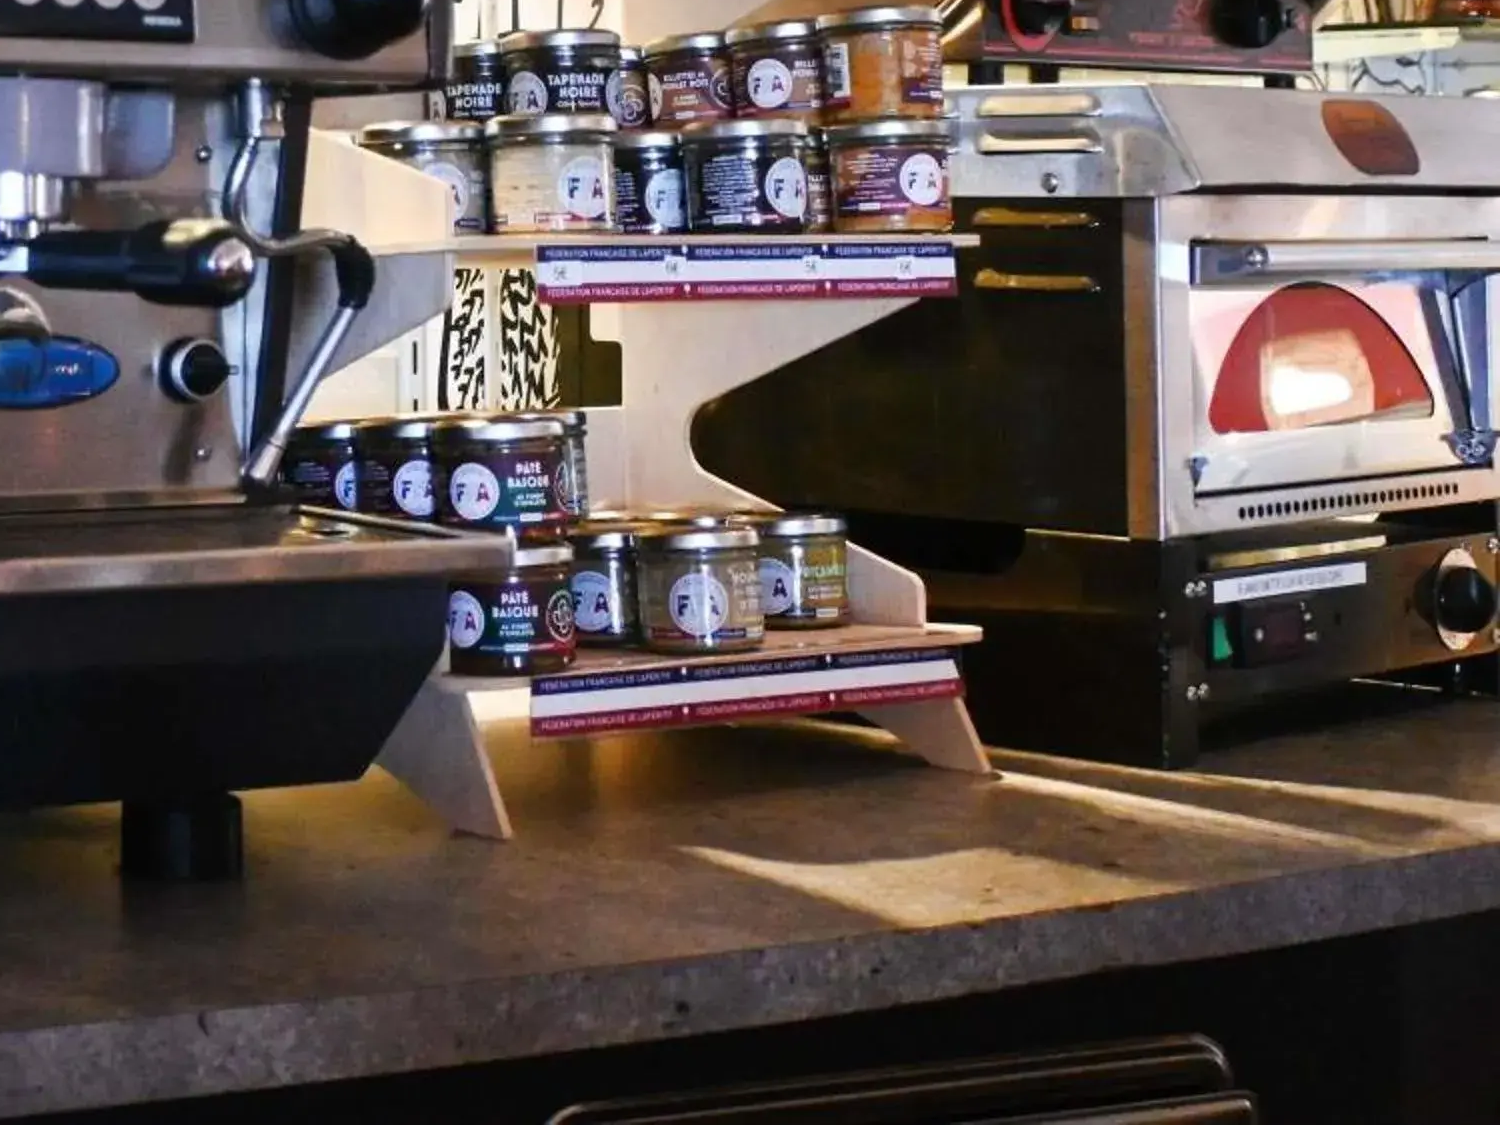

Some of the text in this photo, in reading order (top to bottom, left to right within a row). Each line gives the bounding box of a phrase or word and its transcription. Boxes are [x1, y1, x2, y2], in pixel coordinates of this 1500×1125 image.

[547, 73, 605, 86] TAPENADE
[559, 86, 597, 98] NOIRE
[455, 96, 493, 108] NOIRE
[508, 475, 549, 488] BASQUE
[492, 605, 539, 618] BASQUE
